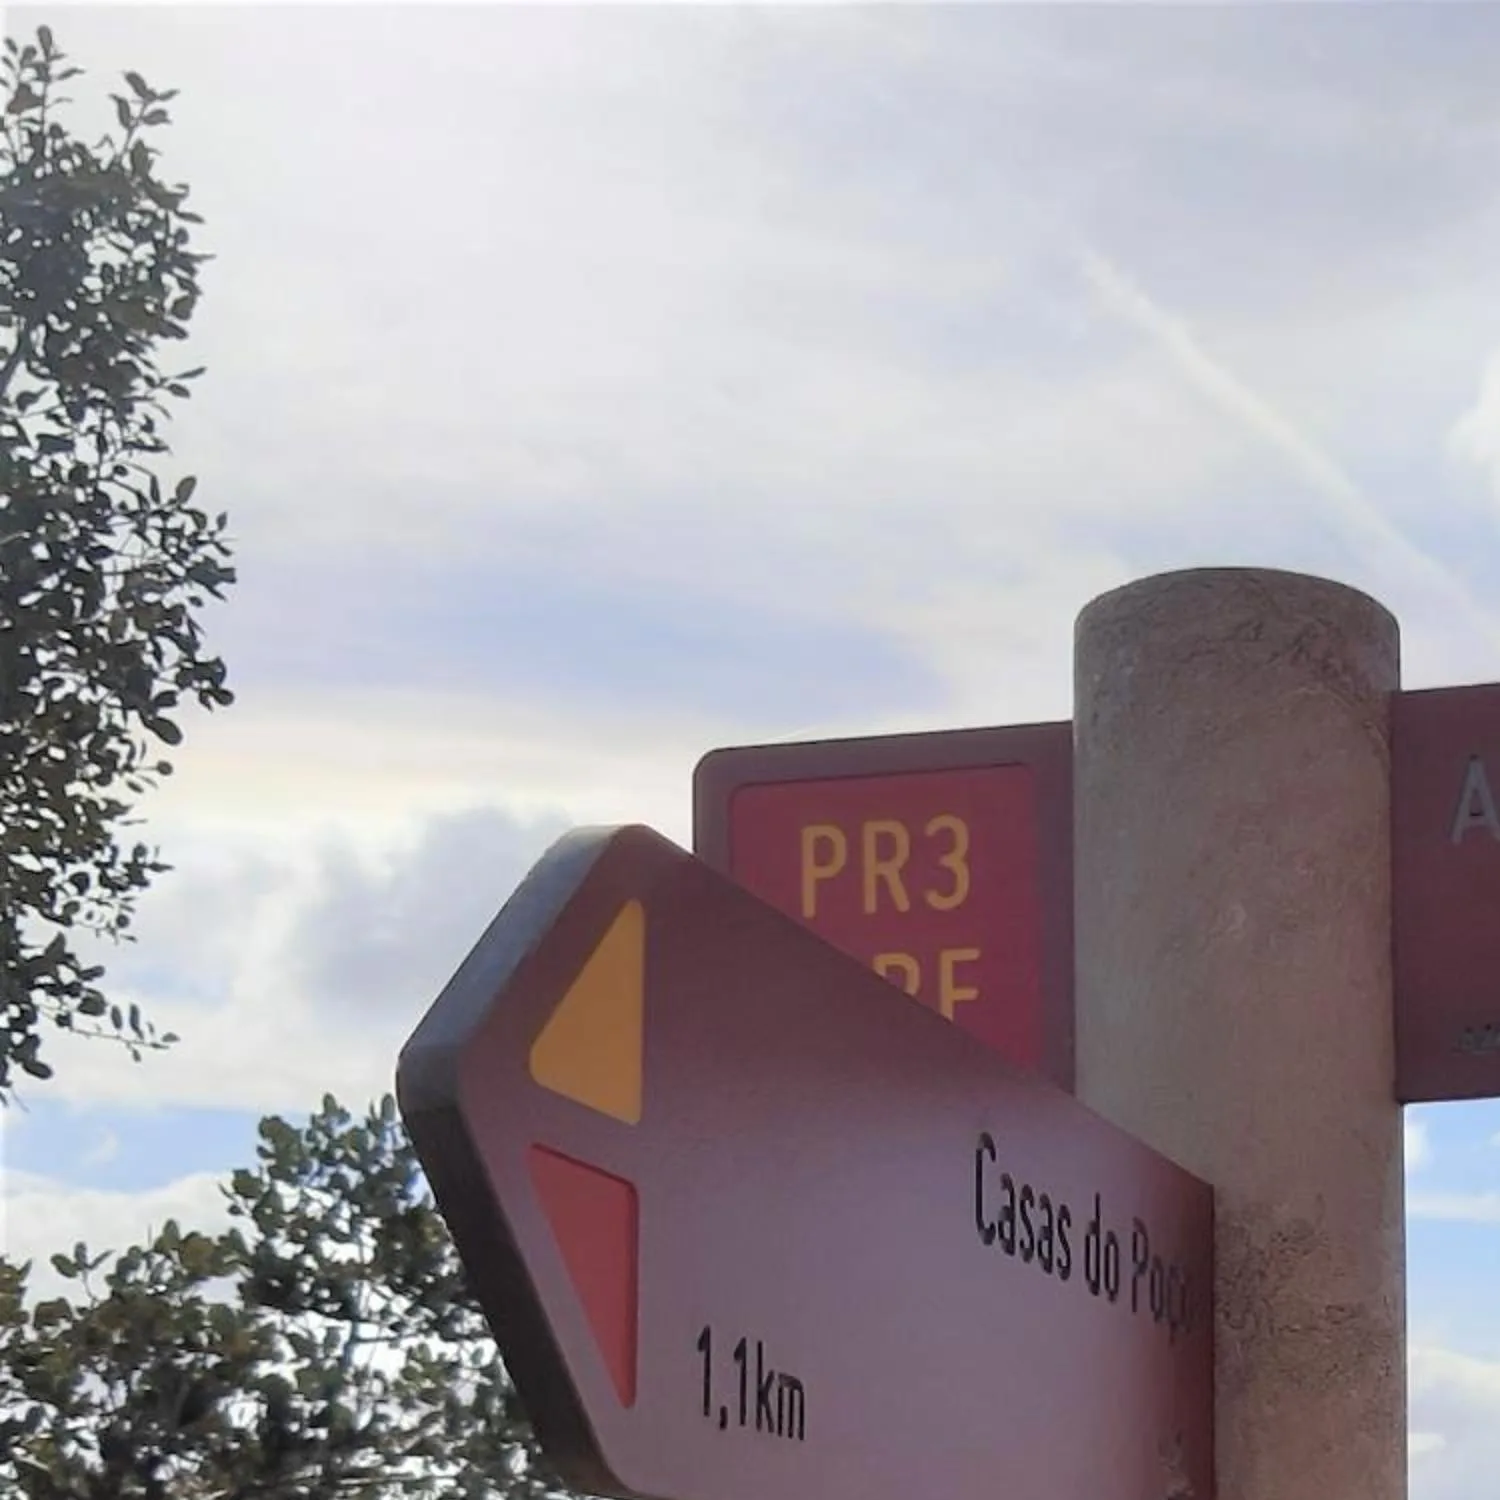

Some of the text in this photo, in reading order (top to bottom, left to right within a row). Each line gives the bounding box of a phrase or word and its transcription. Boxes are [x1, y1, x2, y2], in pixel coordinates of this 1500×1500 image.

[800, 813, 971, 919] PR3
[974, 1131, 1072, 1282] Casas
[1084, 1191, 1120, 1304] do
[696, 1324, 805, 1441] 1,1km
